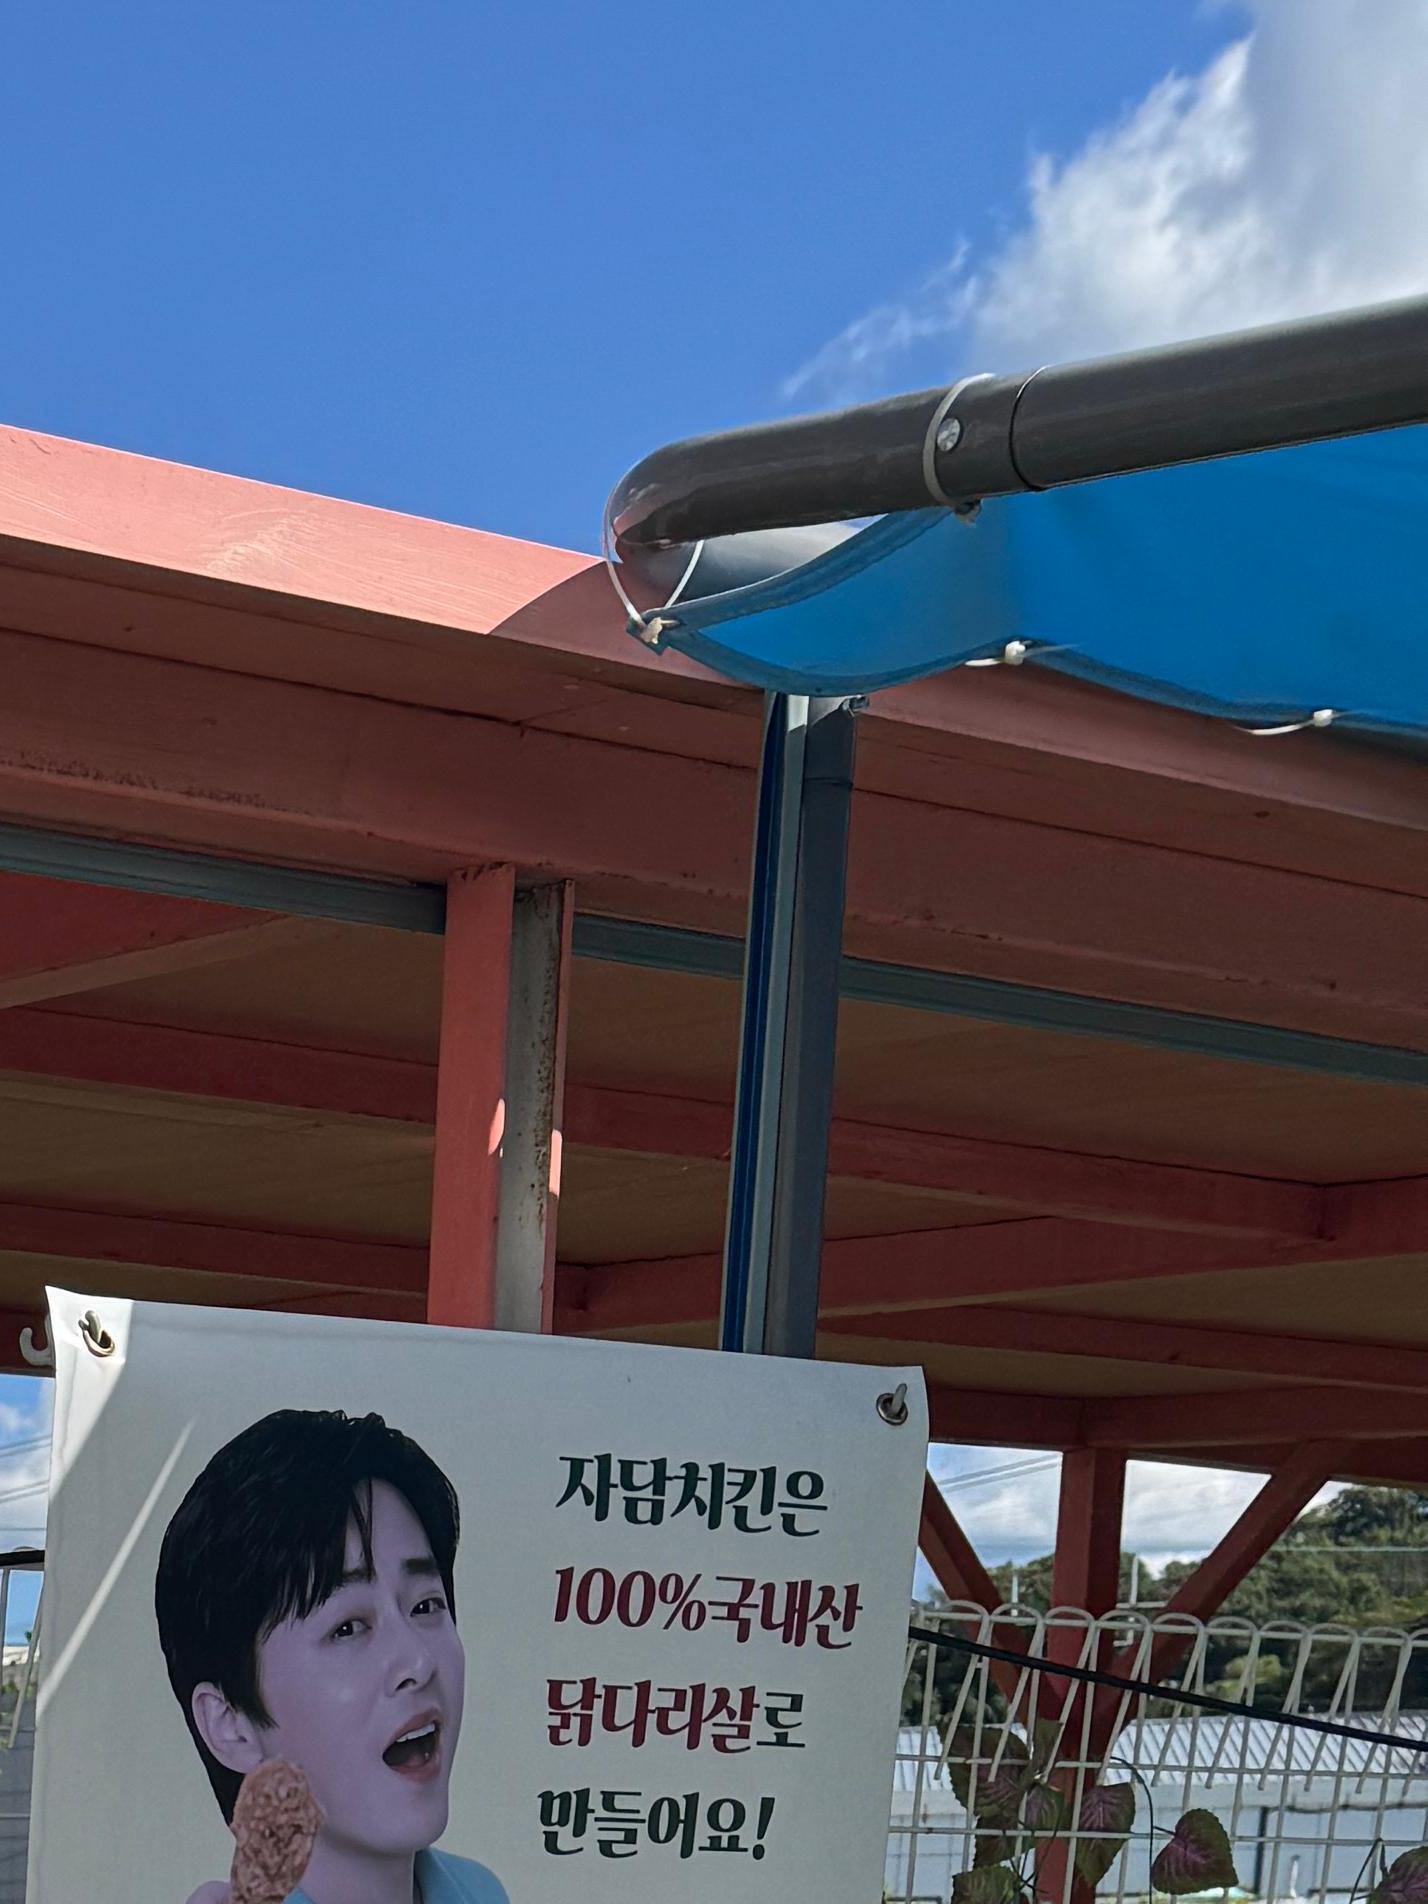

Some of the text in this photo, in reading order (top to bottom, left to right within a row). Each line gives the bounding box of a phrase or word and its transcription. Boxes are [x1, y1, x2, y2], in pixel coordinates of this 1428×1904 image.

[554, 1453, 828, 1538] 자담치킨은
[553, 1565, 864, 1650] 100%국내산
[545, 1678, 806, 1753] 닭다리살로
[537, 1787, 775, 1860] 만들어요!
